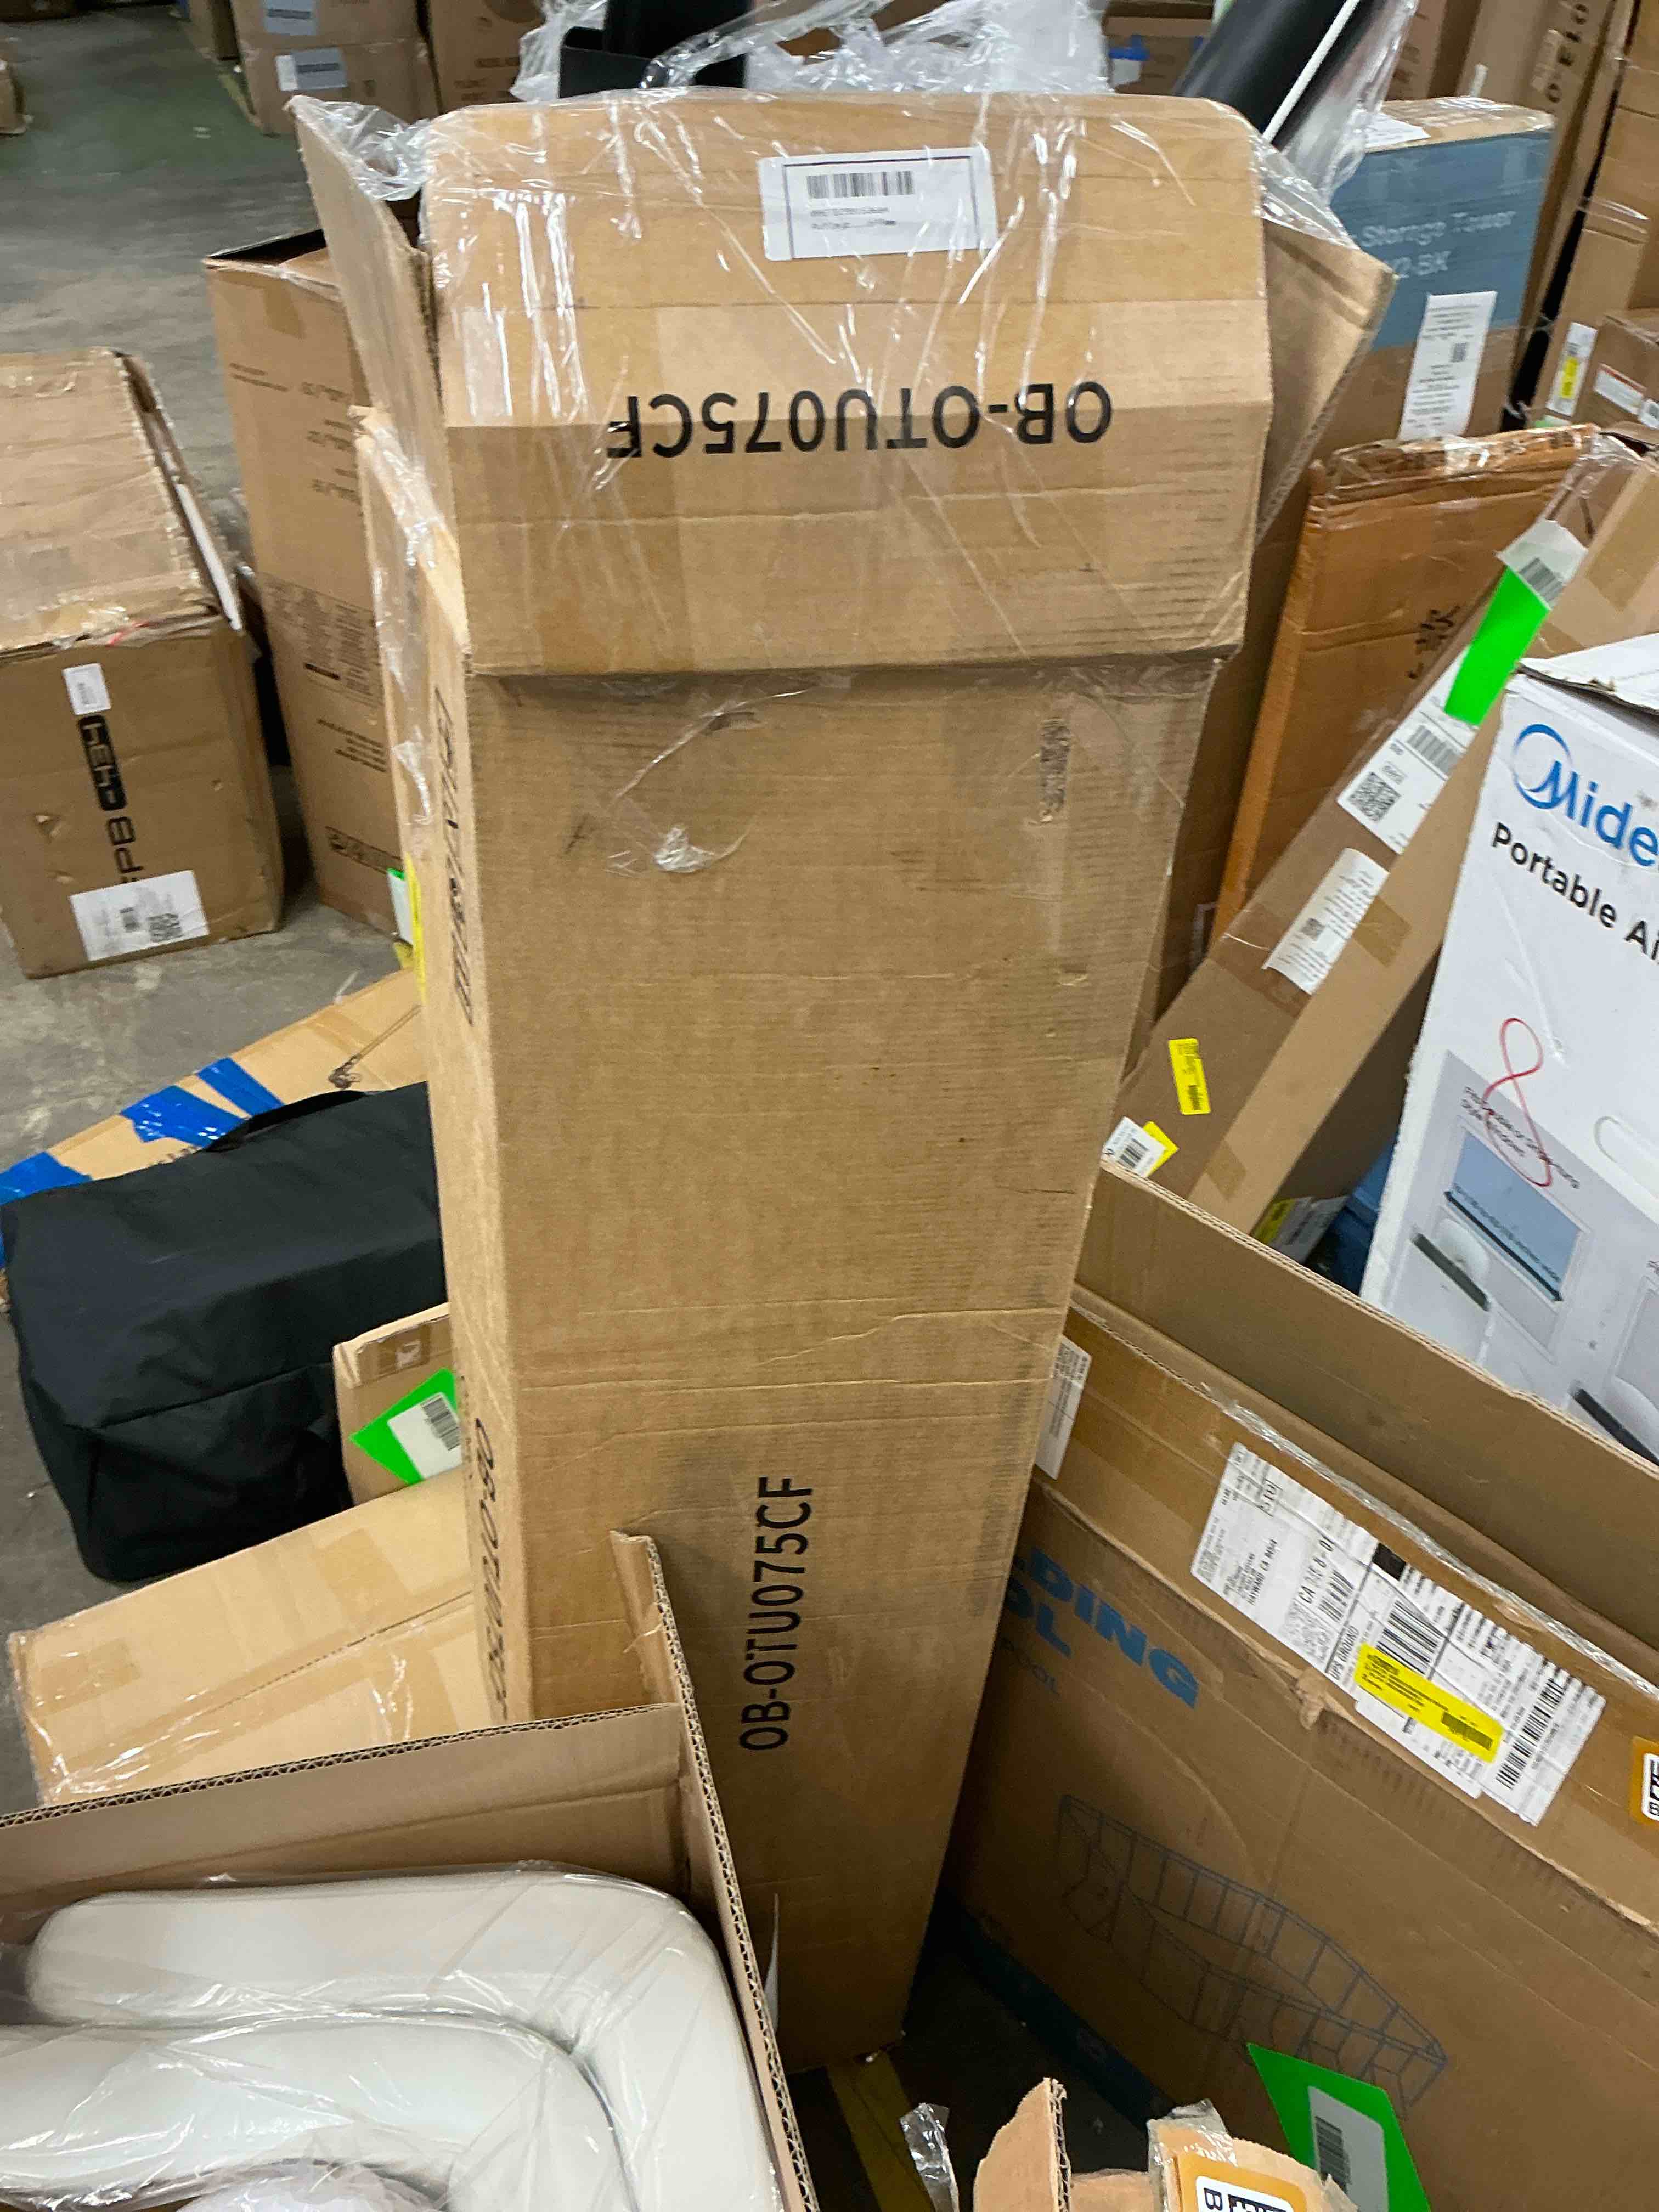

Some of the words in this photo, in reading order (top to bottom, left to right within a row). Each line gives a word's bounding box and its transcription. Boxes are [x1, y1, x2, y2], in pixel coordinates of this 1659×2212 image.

[606, 381, 1114, 459] OB-OTU075CF
[1512, 724, 1659, 867] Mide
[1491, 822, 1617, 928] Portable
[1623, 920, 1659, 965] Ai
[738, 1476, 813, 1751] OB-OTU075CF
[1298, 1585, 1316, 1604] CA
[1328, 1660, 1344, 1681] UPS
[1337, 1624, 1360, 1663] GROUND
